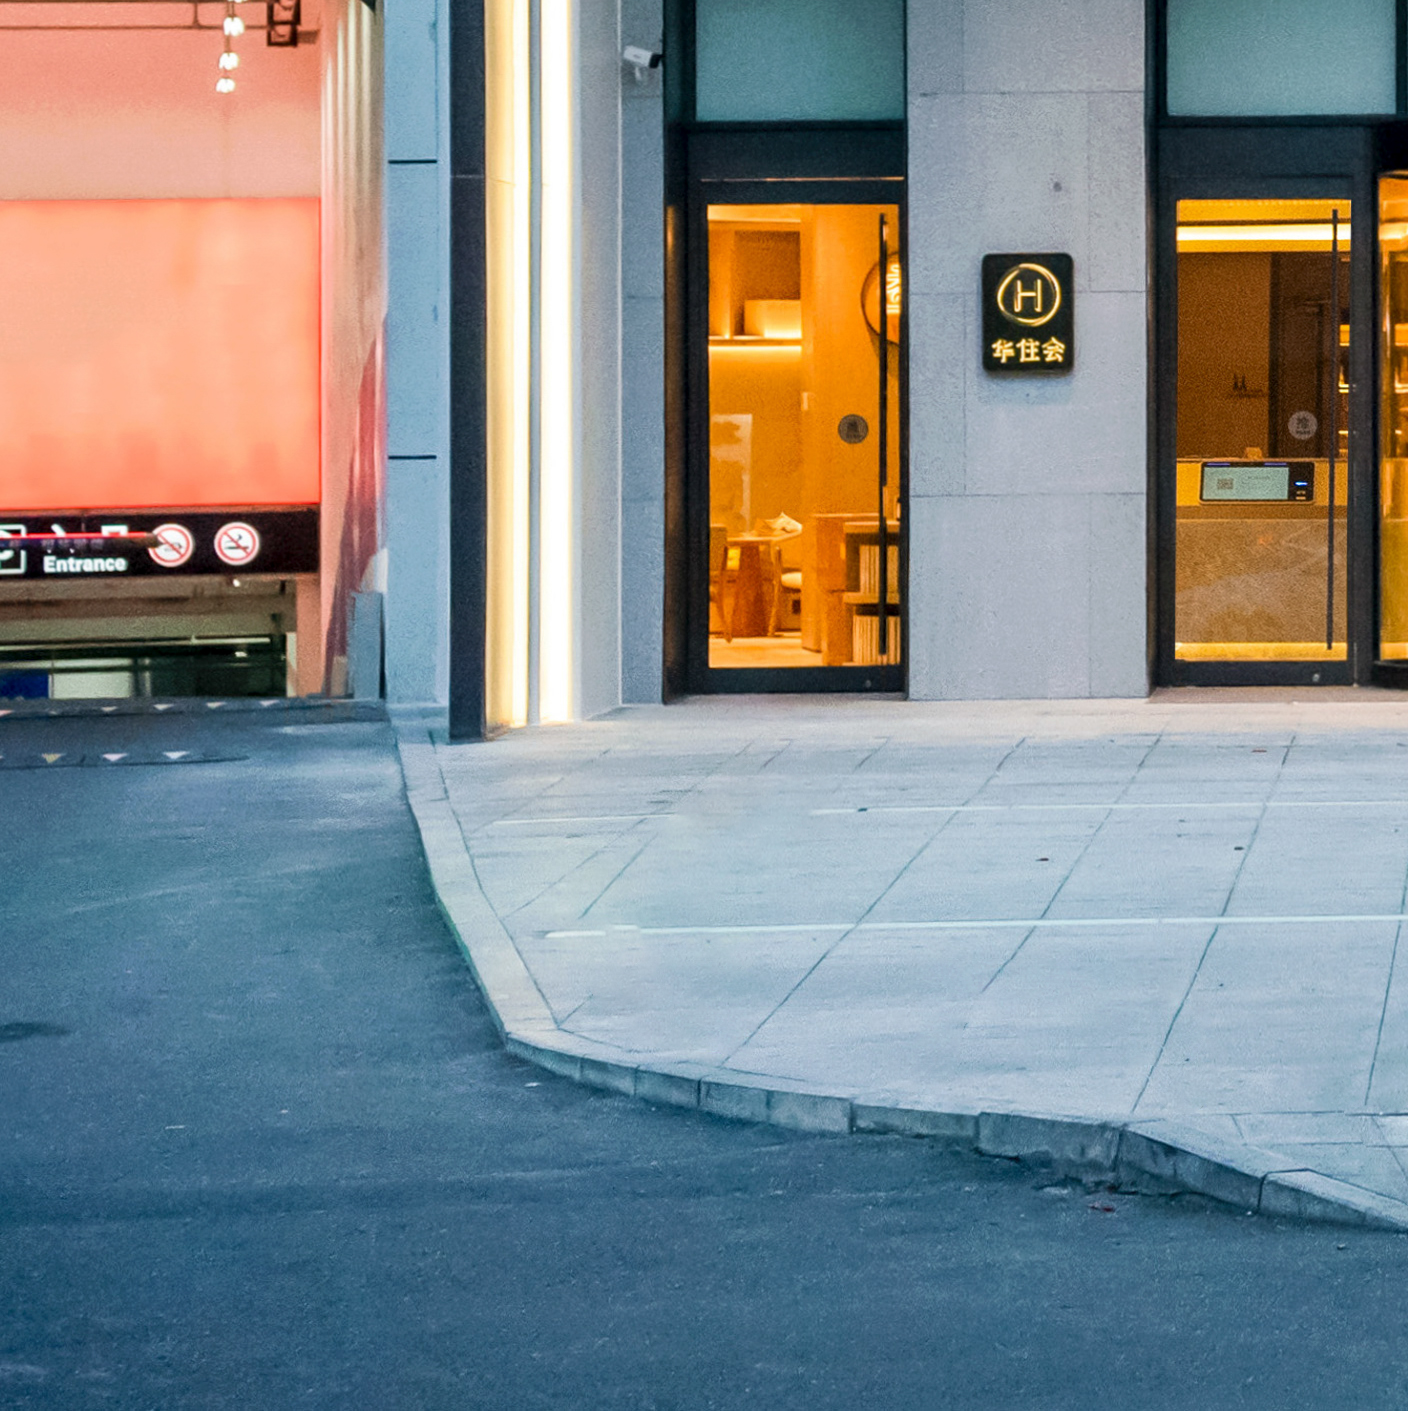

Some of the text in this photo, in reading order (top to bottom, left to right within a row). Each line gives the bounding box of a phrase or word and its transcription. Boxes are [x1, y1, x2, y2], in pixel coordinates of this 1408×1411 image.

[991, 336, 1066, 364] 华住会
[43, 555, 129, 574] Entrance
